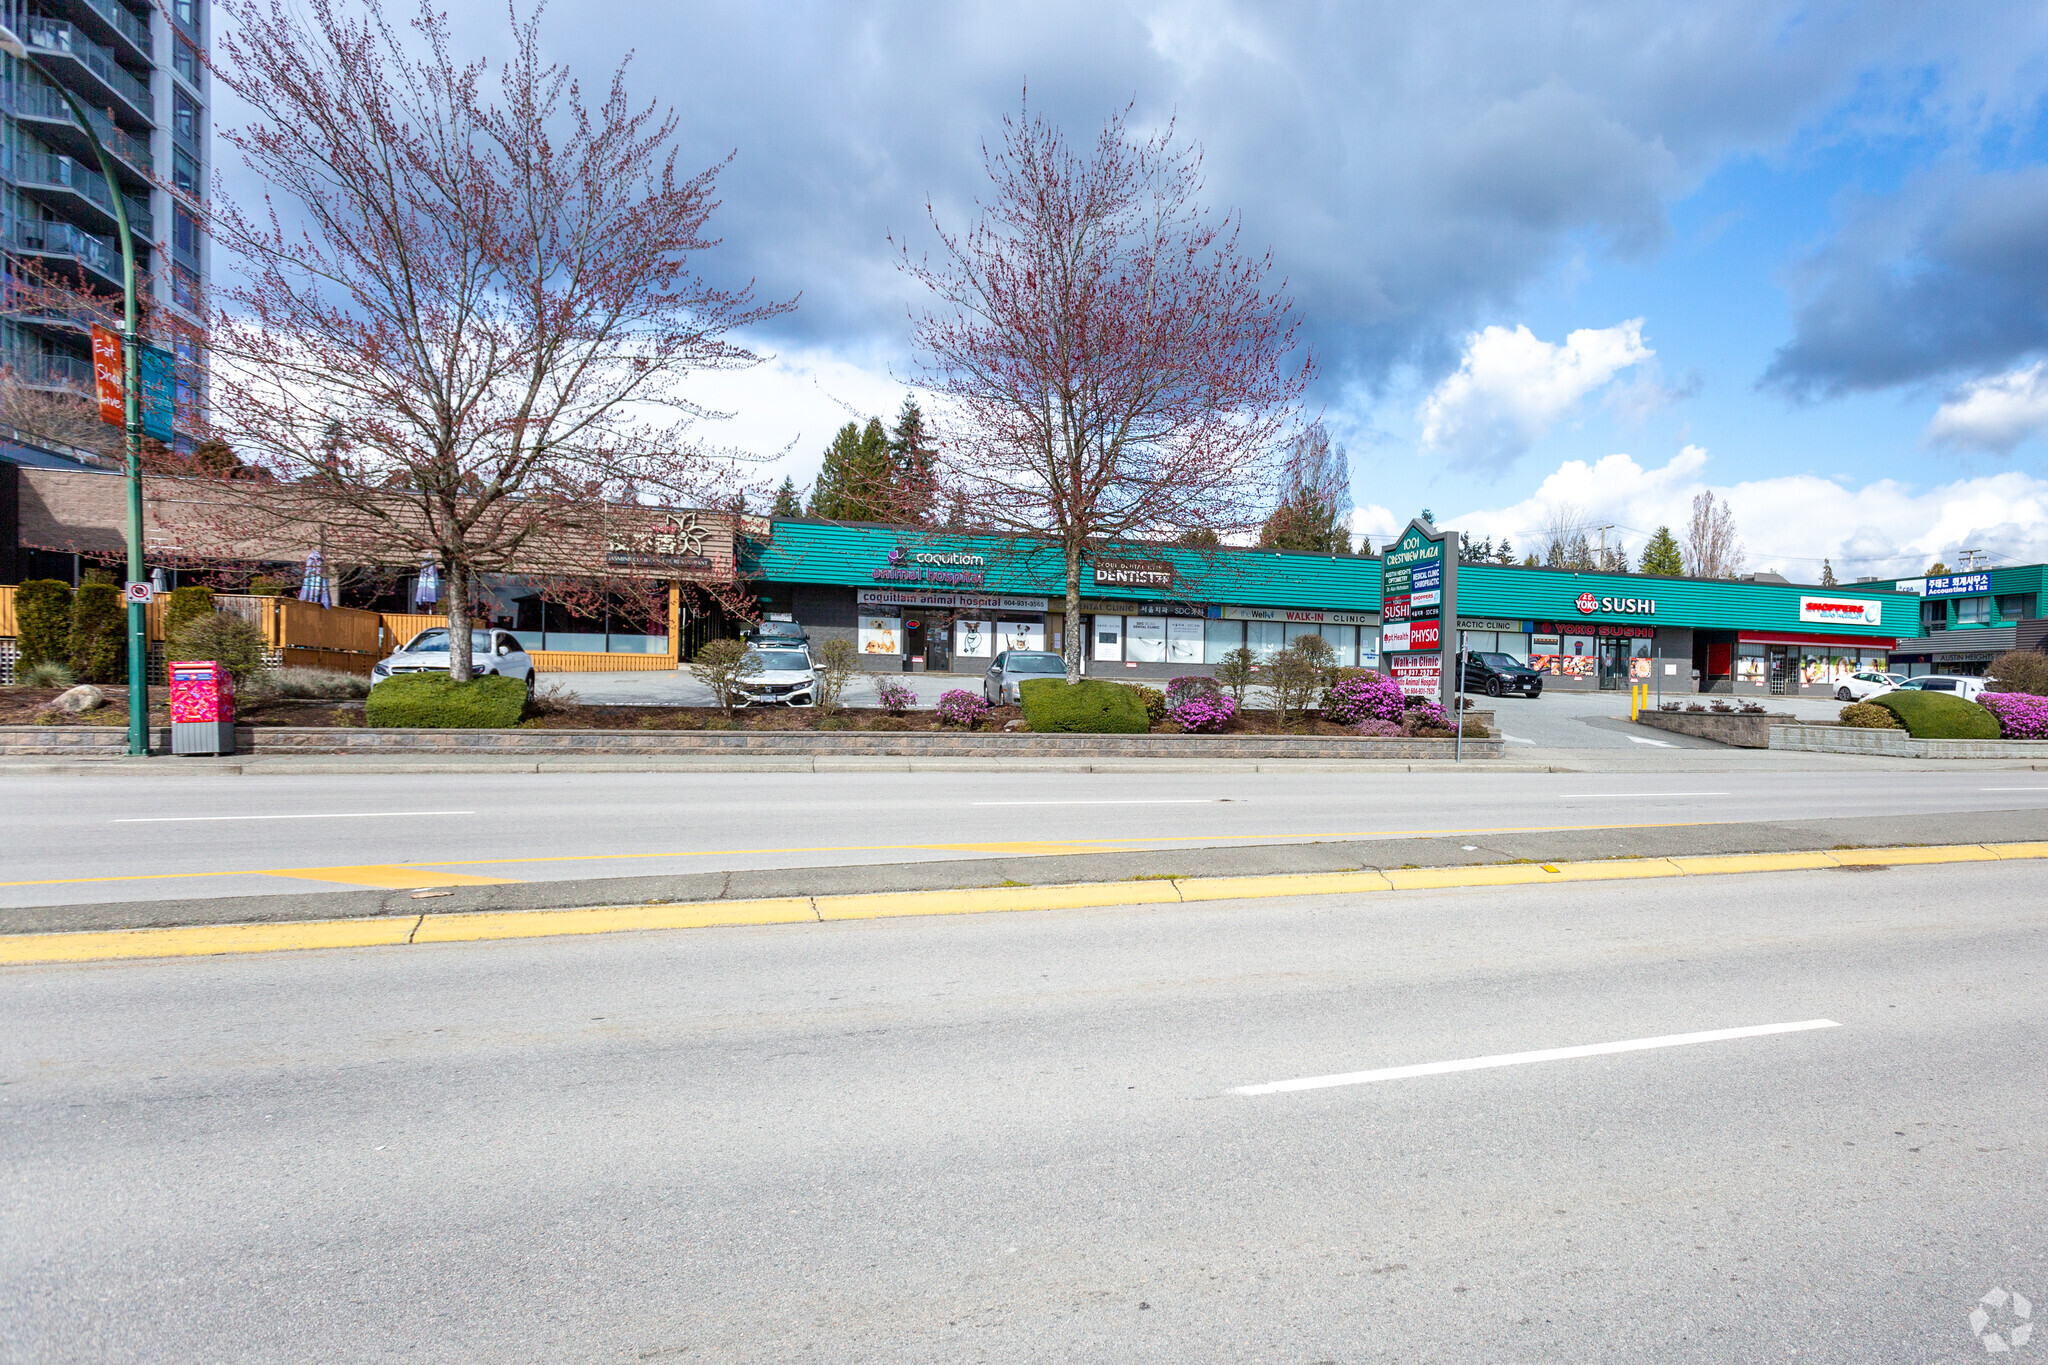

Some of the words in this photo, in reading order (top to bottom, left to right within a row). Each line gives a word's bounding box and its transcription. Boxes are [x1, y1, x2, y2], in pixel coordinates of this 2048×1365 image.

[99, 387, 124, 410] Live.
[1403, 536, 1420, 550] 1001
[916, 552, 984, 566] coquitlam
[1387, 550, 1419, 566] CRESTVIEW
[1420, 546, 1438, 559] PLAZA
[872, 567, 922, 580] animal
[926, 568, 984, 584] hospital
[1096, 570, 1155, 583] DENTIST
[1413, 572, 1427, 580] MEDICAL
[1428, 569, 1439, 578] CLINIC
[1952, 574, 1988, 586] 회계사무소
[1928, 586, 1966, 595] Accounting
[863, 592, 917, 604] coquitlam
[920, 594, 956, 605] animal
[960, 596, 1001, 607] hospital
[1004, 600, 1044, 608] 604-931-3565
[1575, 600, 1599, 610] YOKO
[1602, 597, 1655, 614] SUSHI
[1106, 604, 1134, 612] CLINIC
[1385, 604, 1409, 618] SUSHI
[1805, 602, 1864, 613] SHOPPERS
[1286, 612, 1324, 622] WALK-IN
[1334, 615, 1365, 623] CLINIC
[1394, 632, 1409, 641] Health
[1411, 628, 1439, 643] PHYSIO
[1555, 624, 1595, 635] YOKO
[1599, 626, 1654, 637] SUSHI
[1394, 657, 1418, 667] Walk-in
[1419, 656, 1438, 667] Clinic
[1405, 678, 1420, 686] Animal
[1421, 678, 1438, 687] Hospital
